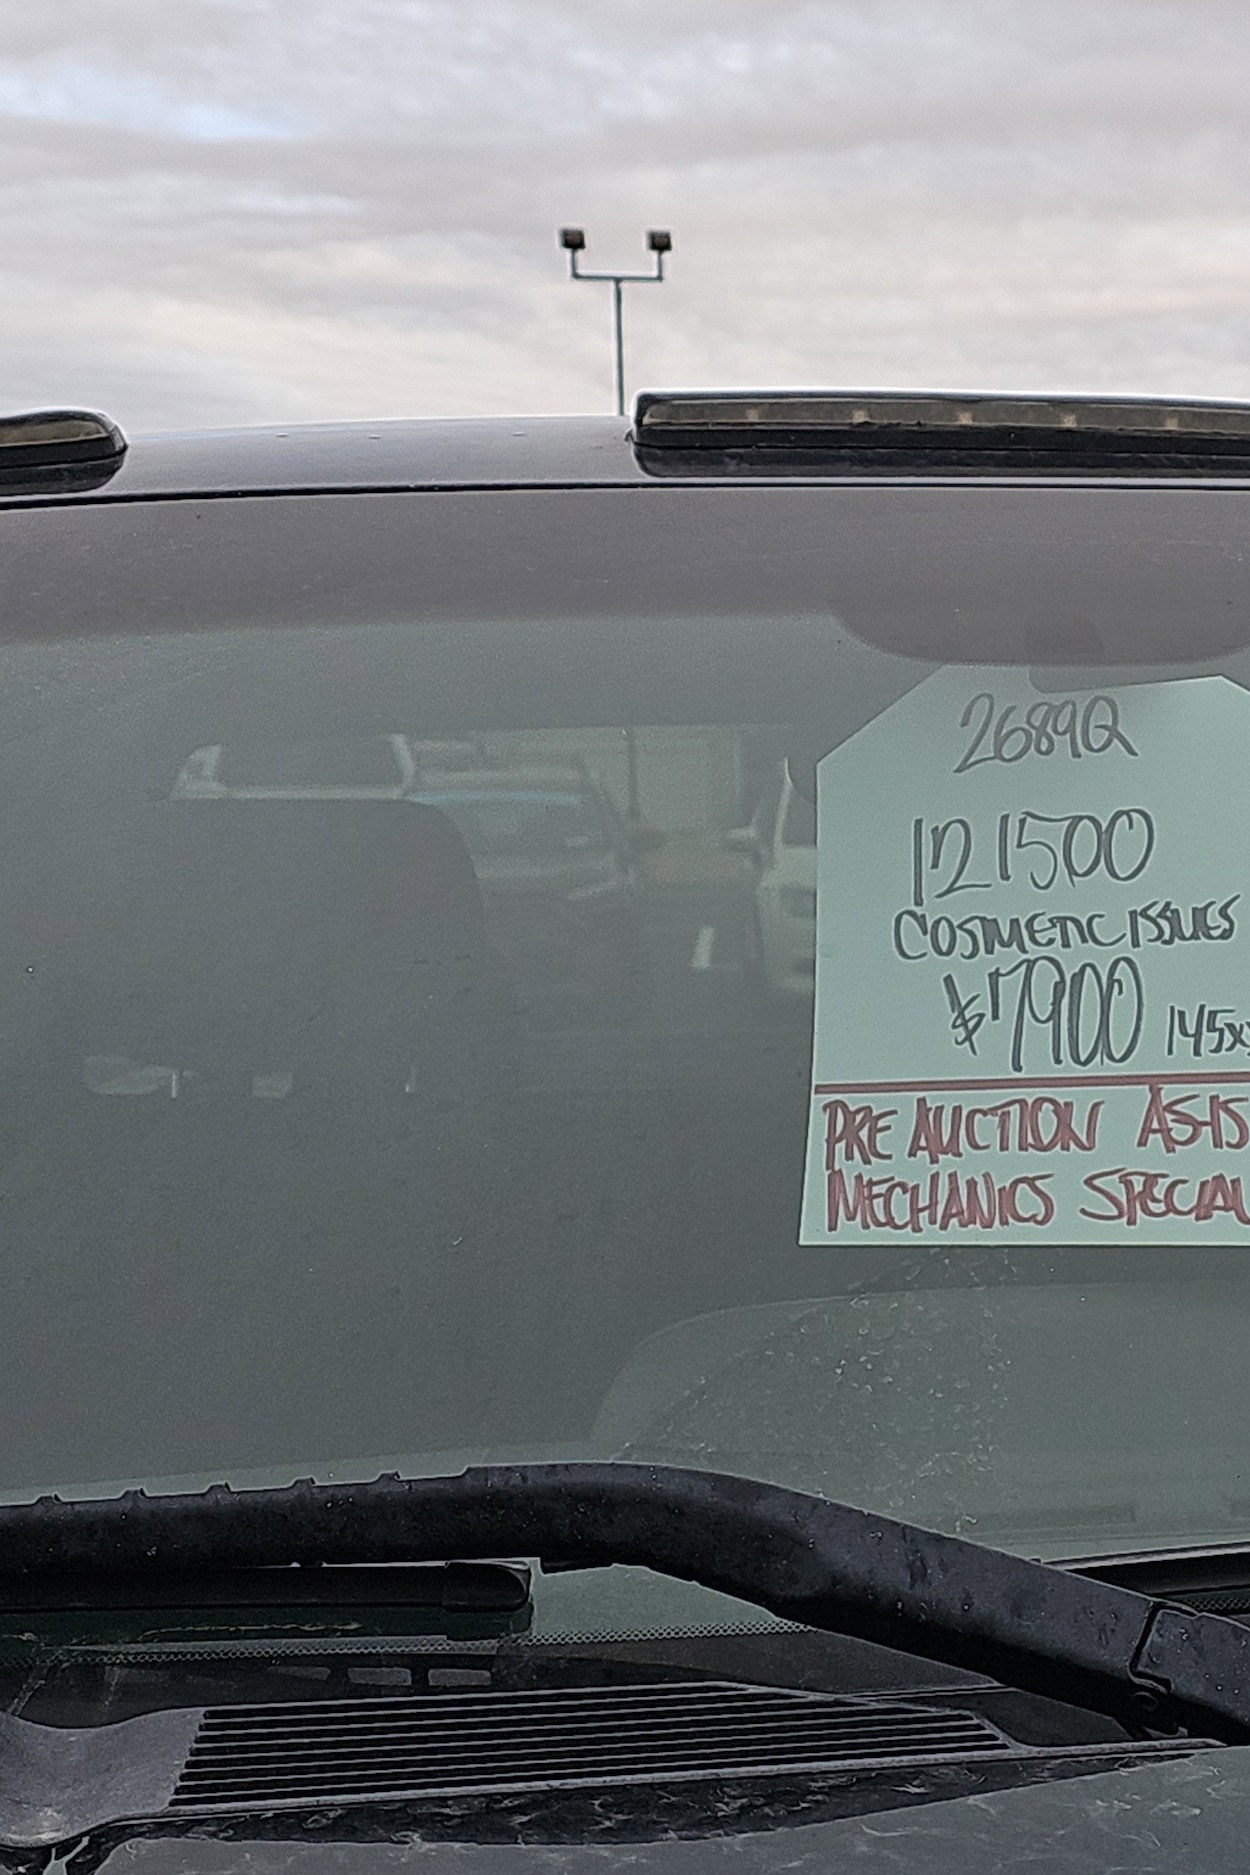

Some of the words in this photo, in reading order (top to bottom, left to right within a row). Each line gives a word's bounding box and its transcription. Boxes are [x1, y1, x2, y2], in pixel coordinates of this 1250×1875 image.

[953, 692, 1140, 774] 2689Q
[894, 909, 1127, 960] COSMETIC
[1128, 893, 1241, 949] ISSUES
[821, 1099, 899, 1171] PRE
[907, 1096, 1104, 1165] AUCTION
[826, 1169, 1055, 1233] MECHANICS
